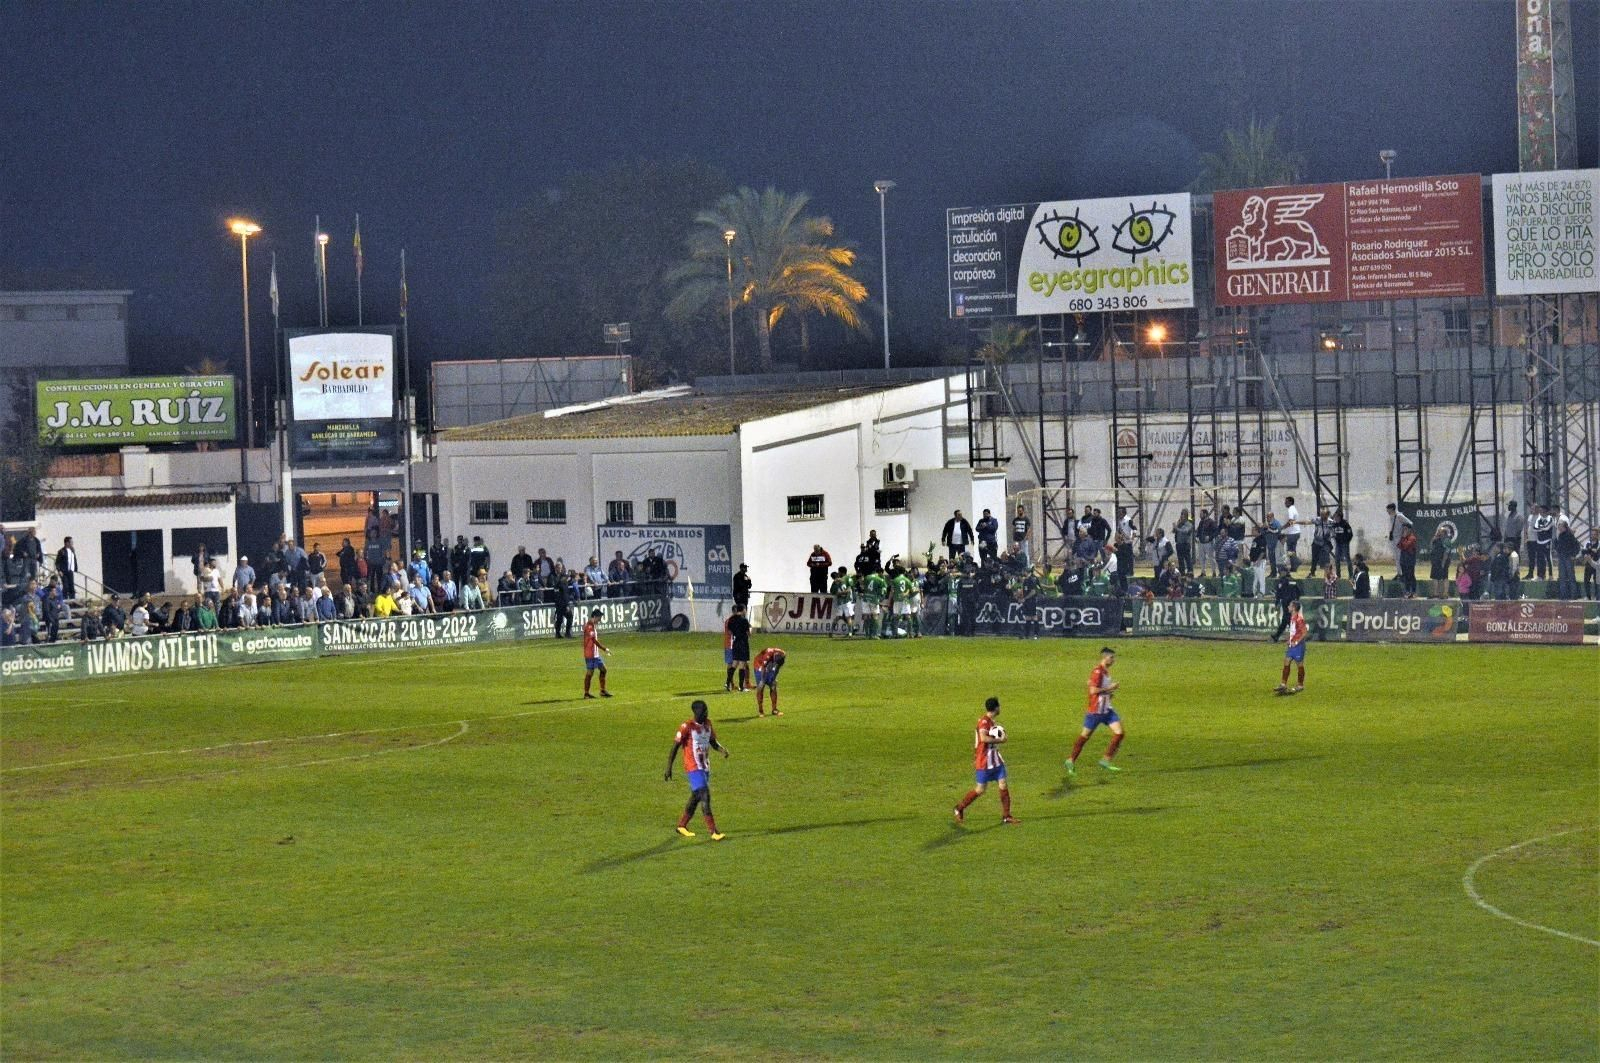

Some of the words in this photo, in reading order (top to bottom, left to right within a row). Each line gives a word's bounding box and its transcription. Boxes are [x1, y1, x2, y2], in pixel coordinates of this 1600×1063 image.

[1349, 184, 1379, 196] Rafael
[1381, 182, 1433, 194] Hermosilla
[1435, 180, 1459, 191] Soto
[1506, 184, 1522, 193] HAY
[1525, 181, 1544, 191] MÁS
[1547, 182, 1559, 191] DE
[1506, 193, 1539, 203] VINOS
[1542, 190, 1592, 202] BLANCOS
[952, 209, 994, 226] impresión
[997, 207, 1025, 223] digital
[1506, 205, 1536, 216] PARA
[1540, 203, 1592, 215] DISCUTIR
[1507, 218, 1519, 227] UN
[1522, 217, 1548, 226] FUERA
[1551, 217, 1561, 225] DE
[1564, 215, 1592, 225] JUEGO
[952, 229, 997, 244] rotulación
[1507, 227, 1537, 241] QUE
[1542, 226, 1560, 240] LO
[1565, 226, 1593, 239] PITA
[1351, 242, 1382, 251] Rosario
[1384, 240, 1428, 250] Rodríguez
[1508, 242, 1538, 252] HASTA
[1541, 242, 1552, 251] MI
[953, 248, 1001, 263] decoración
[1351, 251, 1394, 261] Asociados
[1395, 249, 1433, 259] Sanlúcar
[1434, 247, 1456, 257] 2015
[1458, 246, 1473, 256] S.L.
[1508, 252, 1545, 268] PERO
[1551, 251, 1593, 266] SOLO
[953, 268, 996, 282] corpóreos
[1028, 256, 1189, 298] eyesgraphics
[1508, 269, 1524, 280] UN
[1227, 270, 1331, 297] GENERALI
[1069, 298, 1093, 311] 680
[1097, 297, 1120, 310] 343
[1123, 295, 1147, 308] 806
[299, 360, 385, 382] Solear
[46, 384, 118, 392] CONSTRUCCIONES
[47, 400, 122, 428] J.M.
[130, 389, 228, 426] RUÍZ
[327, 423, 360, 431] MANZANILLA
[602, 529, 703, 539] AUTO-RECAMBIOS
[708, 565, 731, 574] PARTS
[868, 579, 874, 591] 4
[899, 579, 906, 592] 3
[522, 604, 588, 630] SANLAR
[1138, 602, 1212, 626] ARENAS
[1317, 604, 1339, 629] SL
[1351, 611, 1421, 634] ProLiga
[323, 620, 396, 645] SANLÚCAR
[401, 615, 478, 641] 2019-2022
[231, 636, 243, 652] el
[246, 635, 312, 654] gatonauta
[423, 638, 443, 646] VUELTA
[454, 635, 476, 643] MUNDO
[87, 641, 154, 675] ¡VAMOS
[157, 634, 218, 669] ATLETI!
[2, 655, 74, 675] gatonauta
